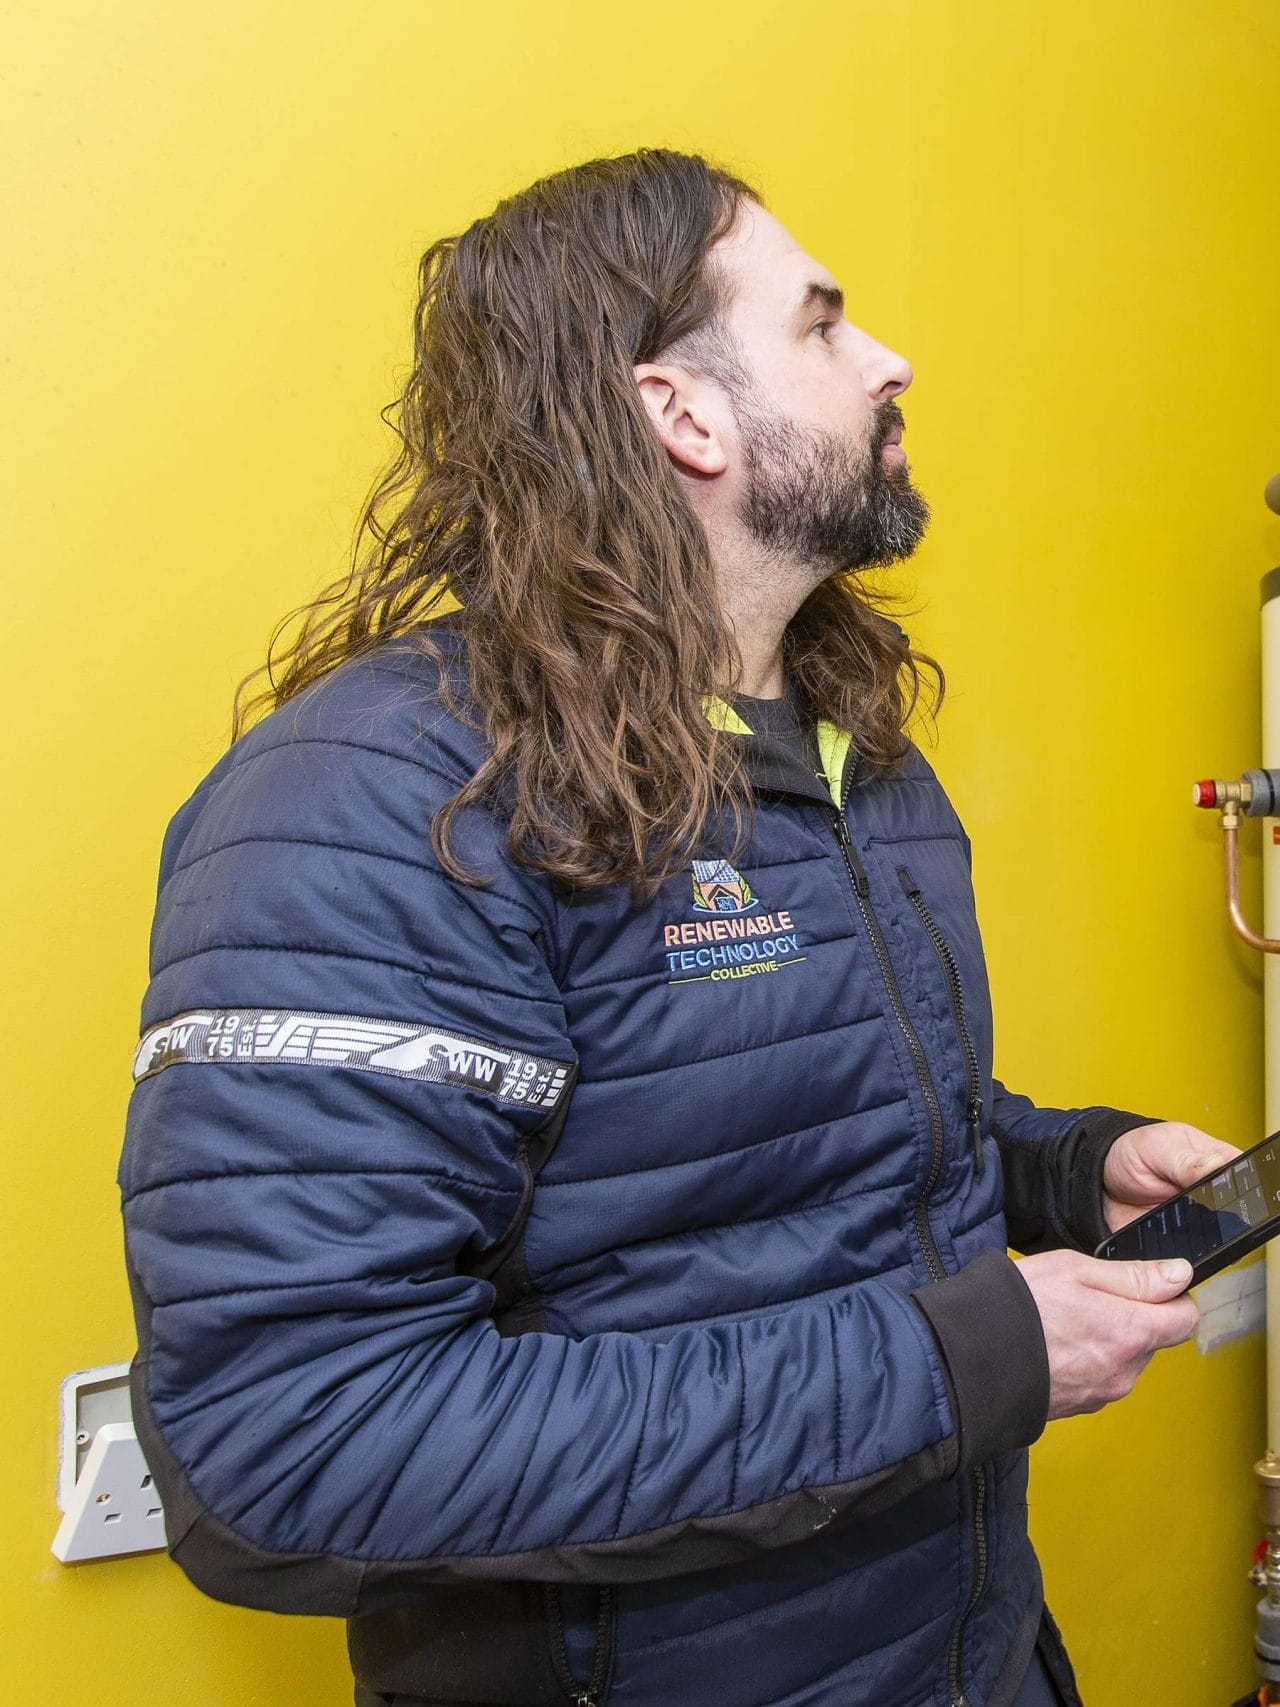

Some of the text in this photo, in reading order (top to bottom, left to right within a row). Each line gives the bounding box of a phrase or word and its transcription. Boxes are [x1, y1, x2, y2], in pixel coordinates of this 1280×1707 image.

[664, 911, 795, 947] RENEWABLE
[666, 934, 801, 972] TECHNOLOGY
[710, 960, 779, 981] COLLECTIVE
[209, 1015, 240, 1035] 19
[205, 1036, 234, 1058] 75
[508, 1058, 538, 1081] 19
[500, 1078, 530, 1101] 75
